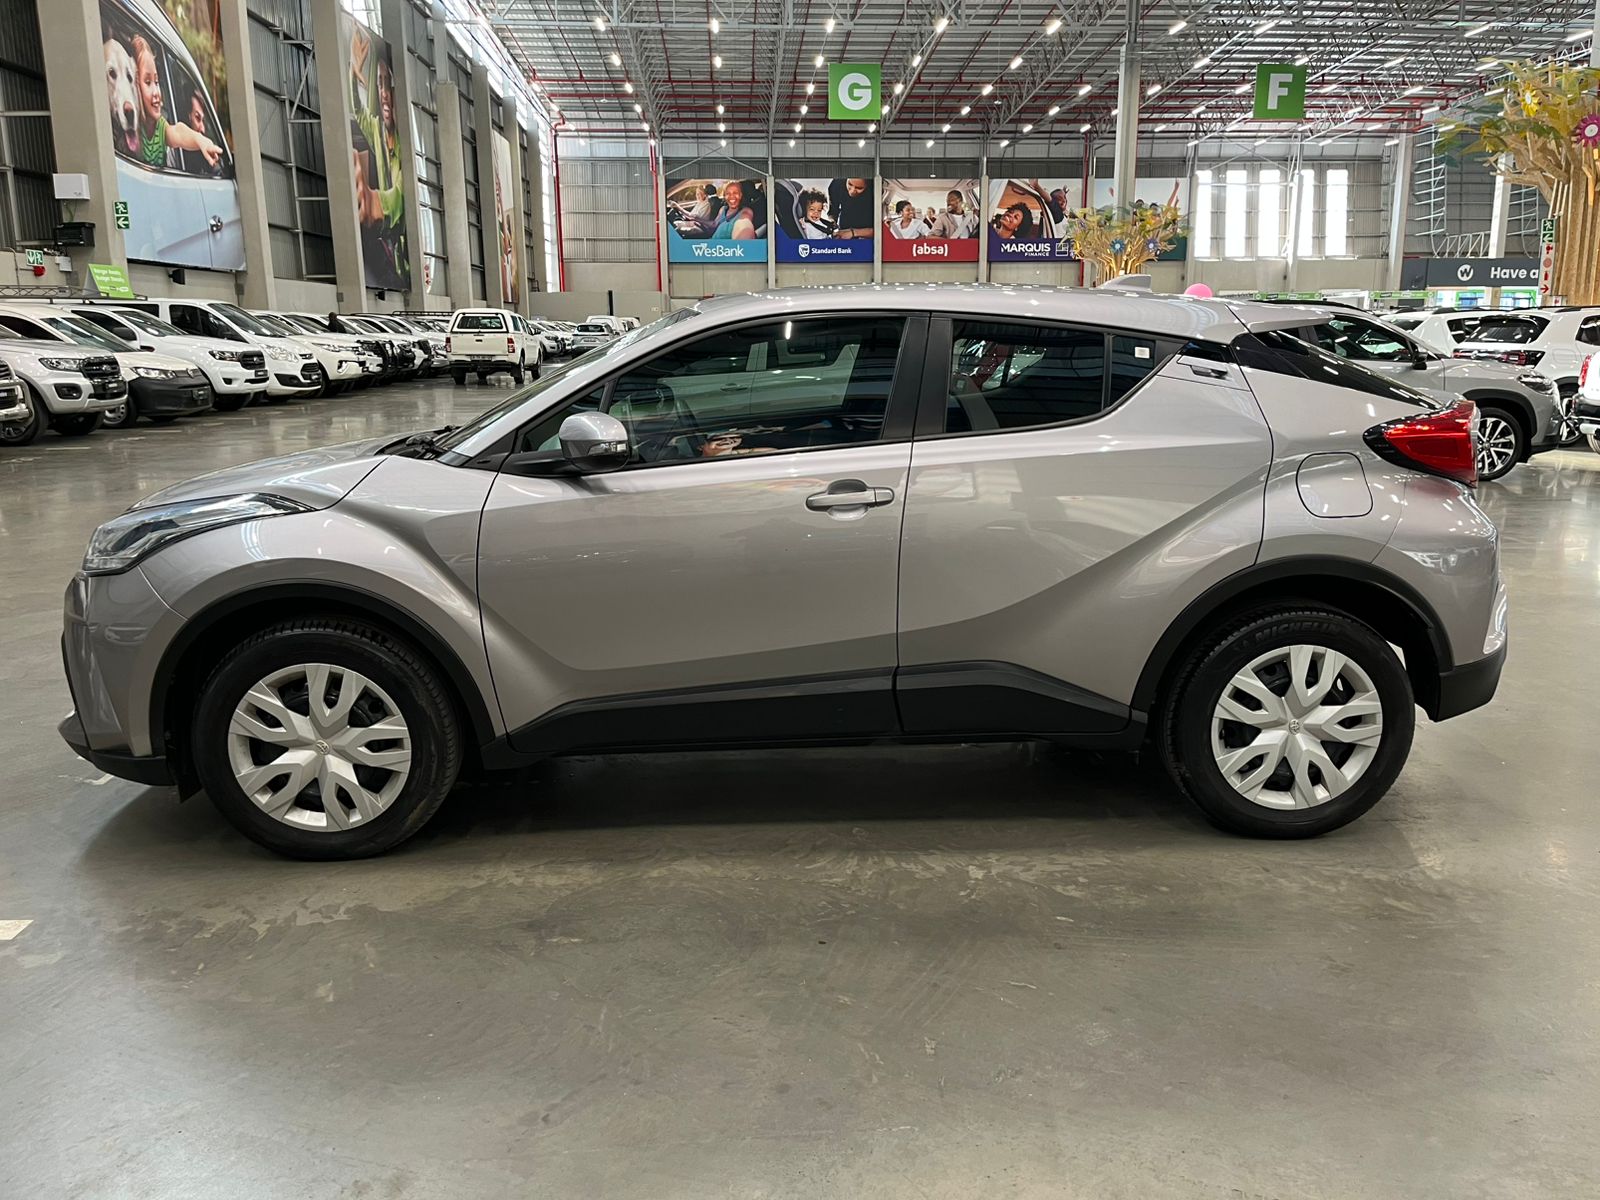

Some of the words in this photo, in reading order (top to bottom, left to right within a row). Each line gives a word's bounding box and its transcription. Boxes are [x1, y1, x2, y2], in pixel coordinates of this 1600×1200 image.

[838, 72, 872, 111] G
[1267, 73, 1293, 109] F
[692, 243, 744, 257] WesBank
[1001, 243, 1051, 252] MARQUIS
[1490, 266, 1527, 279] Have
